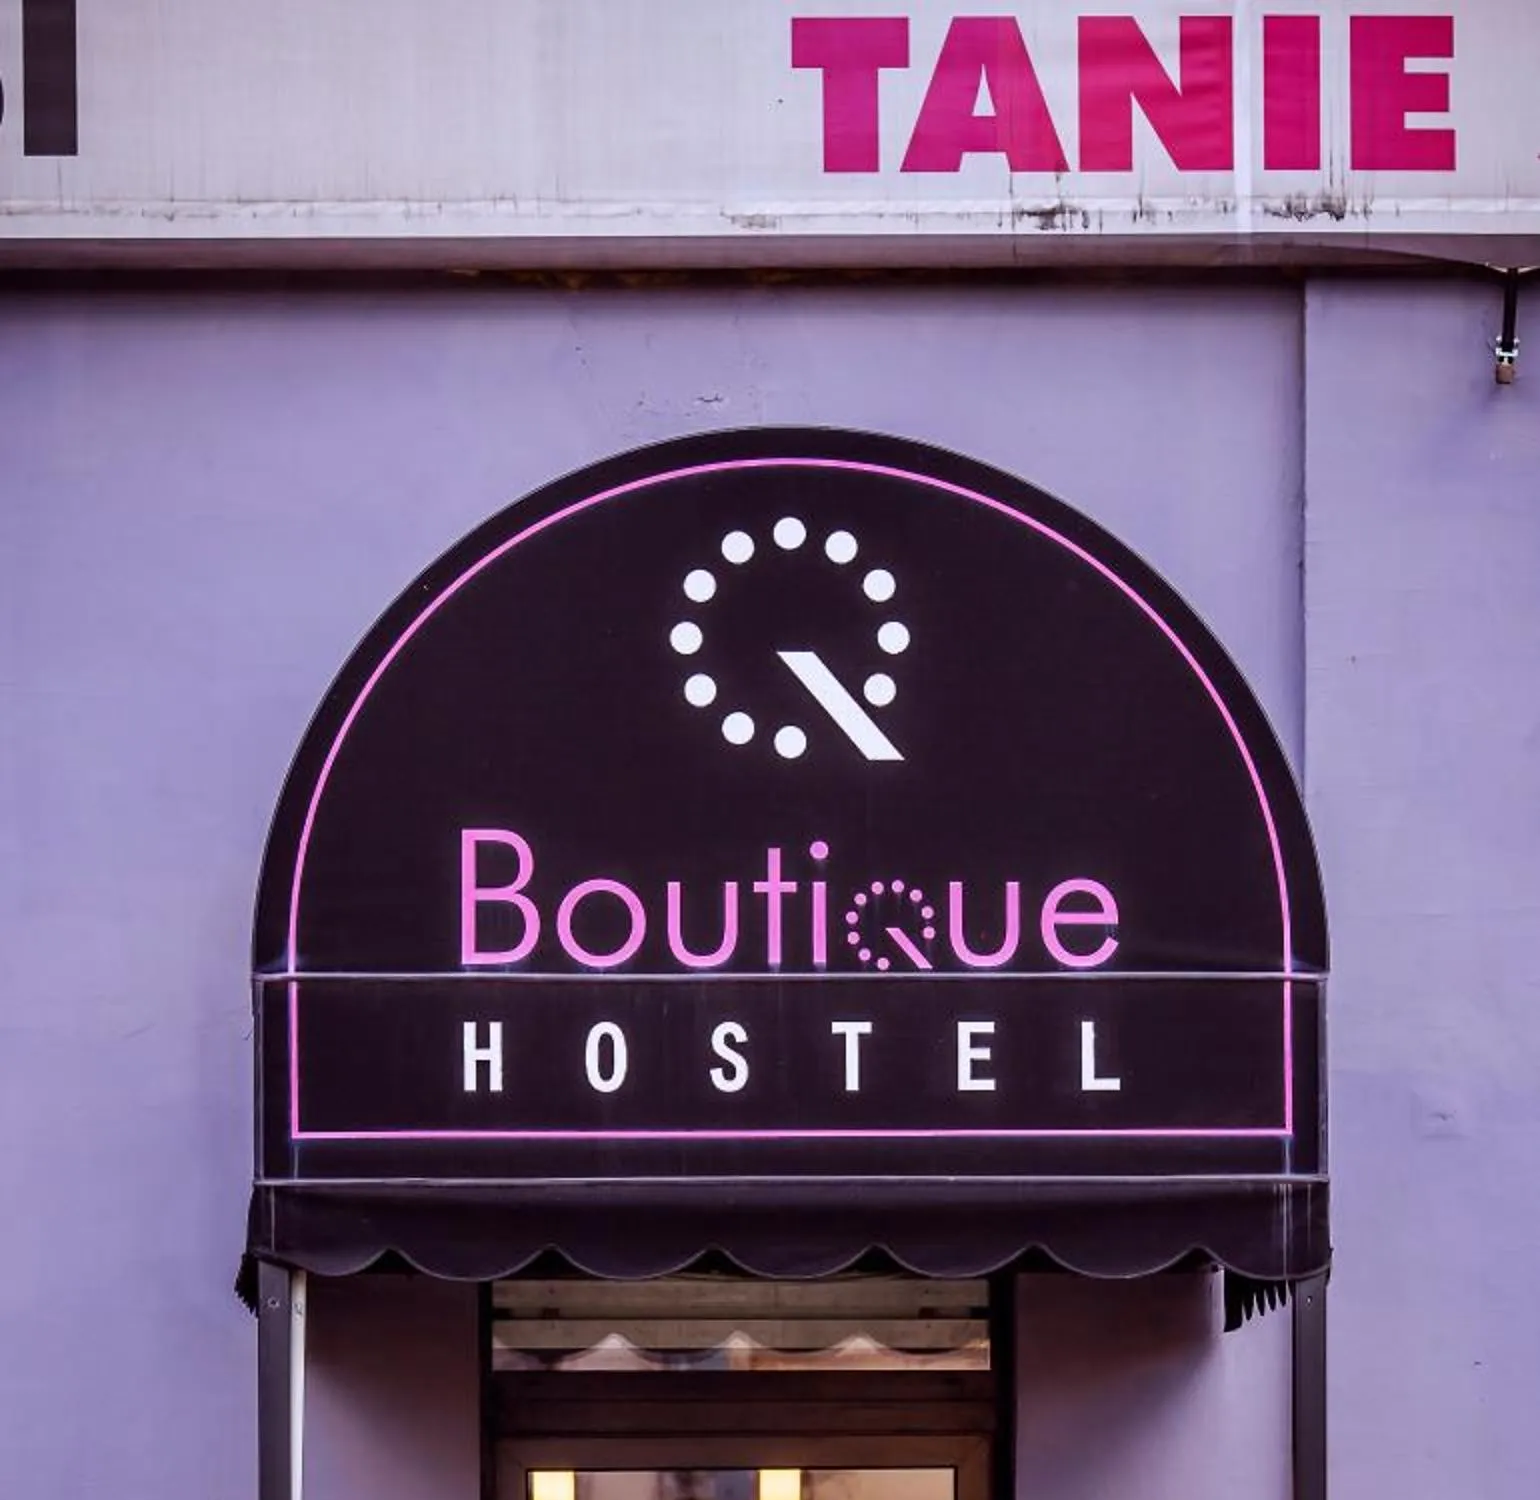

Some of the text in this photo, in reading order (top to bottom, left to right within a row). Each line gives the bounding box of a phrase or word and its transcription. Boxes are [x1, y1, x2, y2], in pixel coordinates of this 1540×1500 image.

[790, 15, 1456, 172] TANIE
[670, 517, 911, 761] Q
[462, 1020, 1122, 1093] HOSTEL
